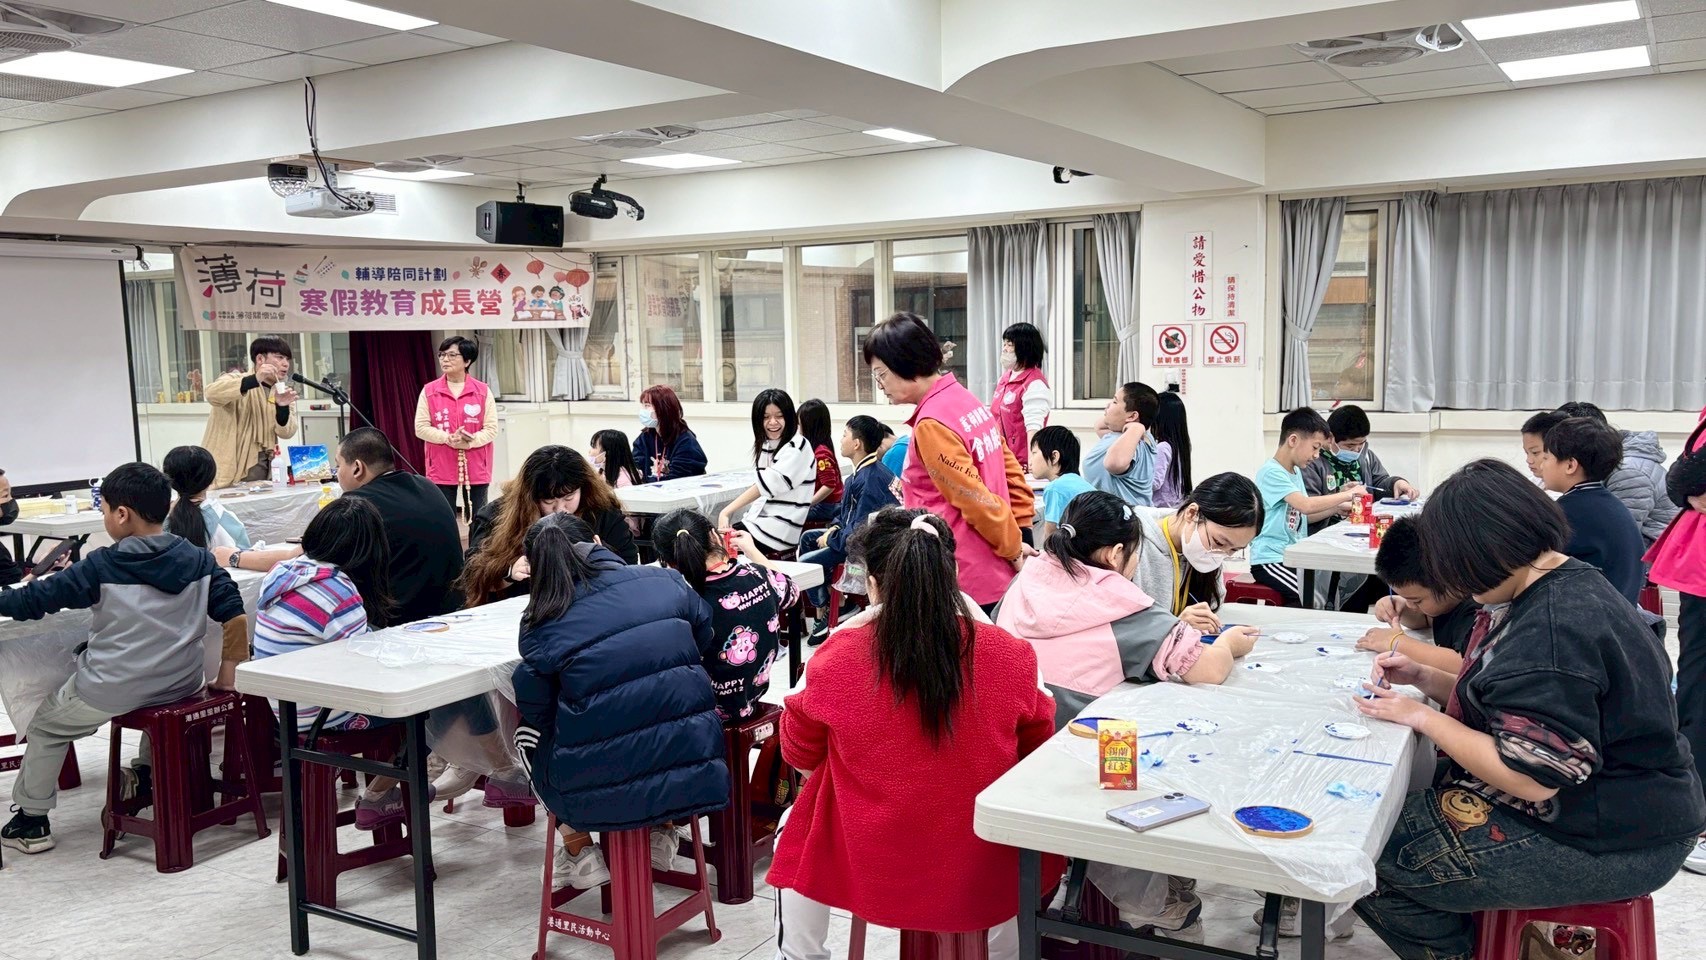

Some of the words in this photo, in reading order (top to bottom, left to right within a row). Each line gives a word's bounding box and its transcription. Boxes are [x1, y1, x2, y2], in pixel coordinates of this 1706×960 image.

[194, 253, 286, 308] 薄荷
[355, 266, 448, 282] 輔導陪同計劃
[1191, 235, 1207, 317] 請愛惜公物
[299, 288, 503, 317] 寒假教育成長營
[740, 581, 769, 603] HAPPY
[711, 677, 745, 690] HAPPY
[547, 916, 611, 941] 港通里民活動中心
